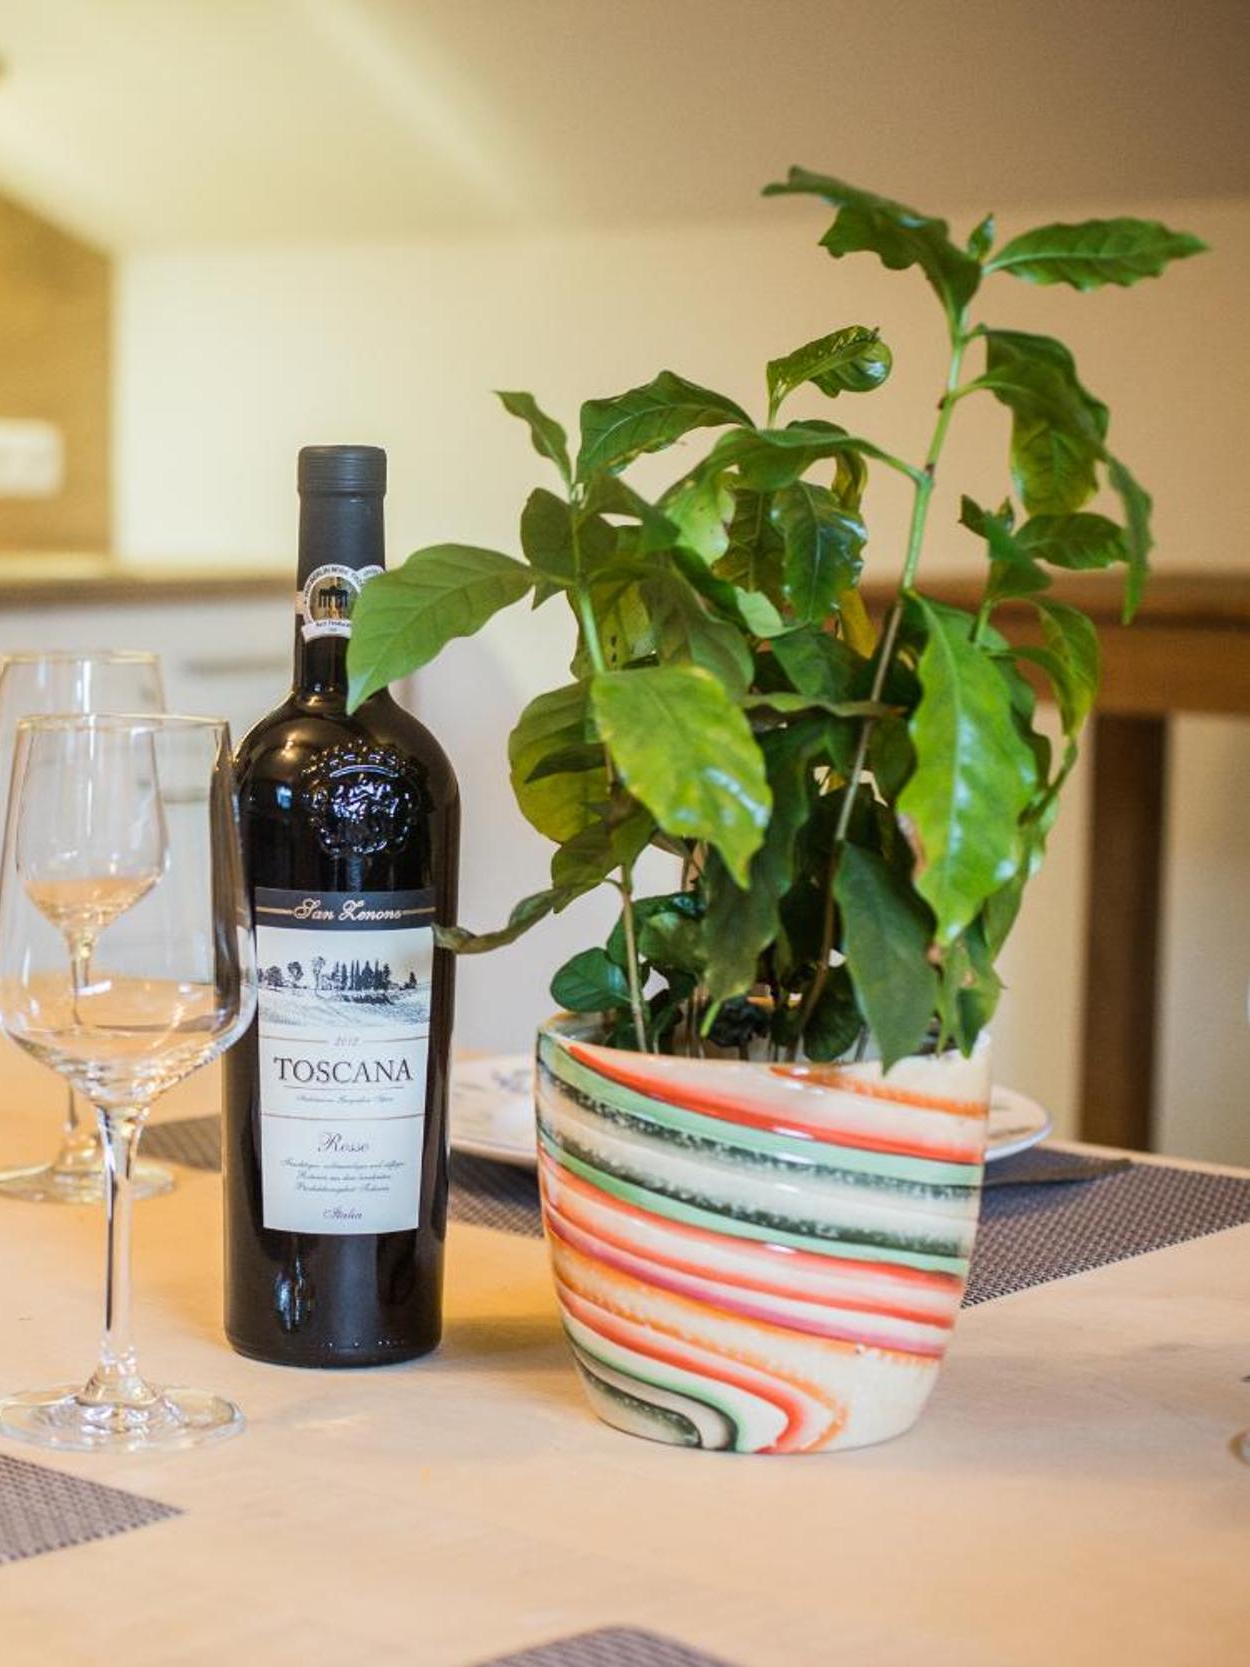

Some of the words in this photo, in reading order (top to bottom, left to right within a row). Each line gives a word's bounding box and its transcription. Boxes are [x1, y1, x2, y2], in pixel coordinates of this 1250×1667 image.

[293, 898, 334, 920] San
[338, 899, 402, 921] Zenone
[273, 1056, 414, 1084] TOSCANA
[317, 1131, 370, 1153] Rosso
